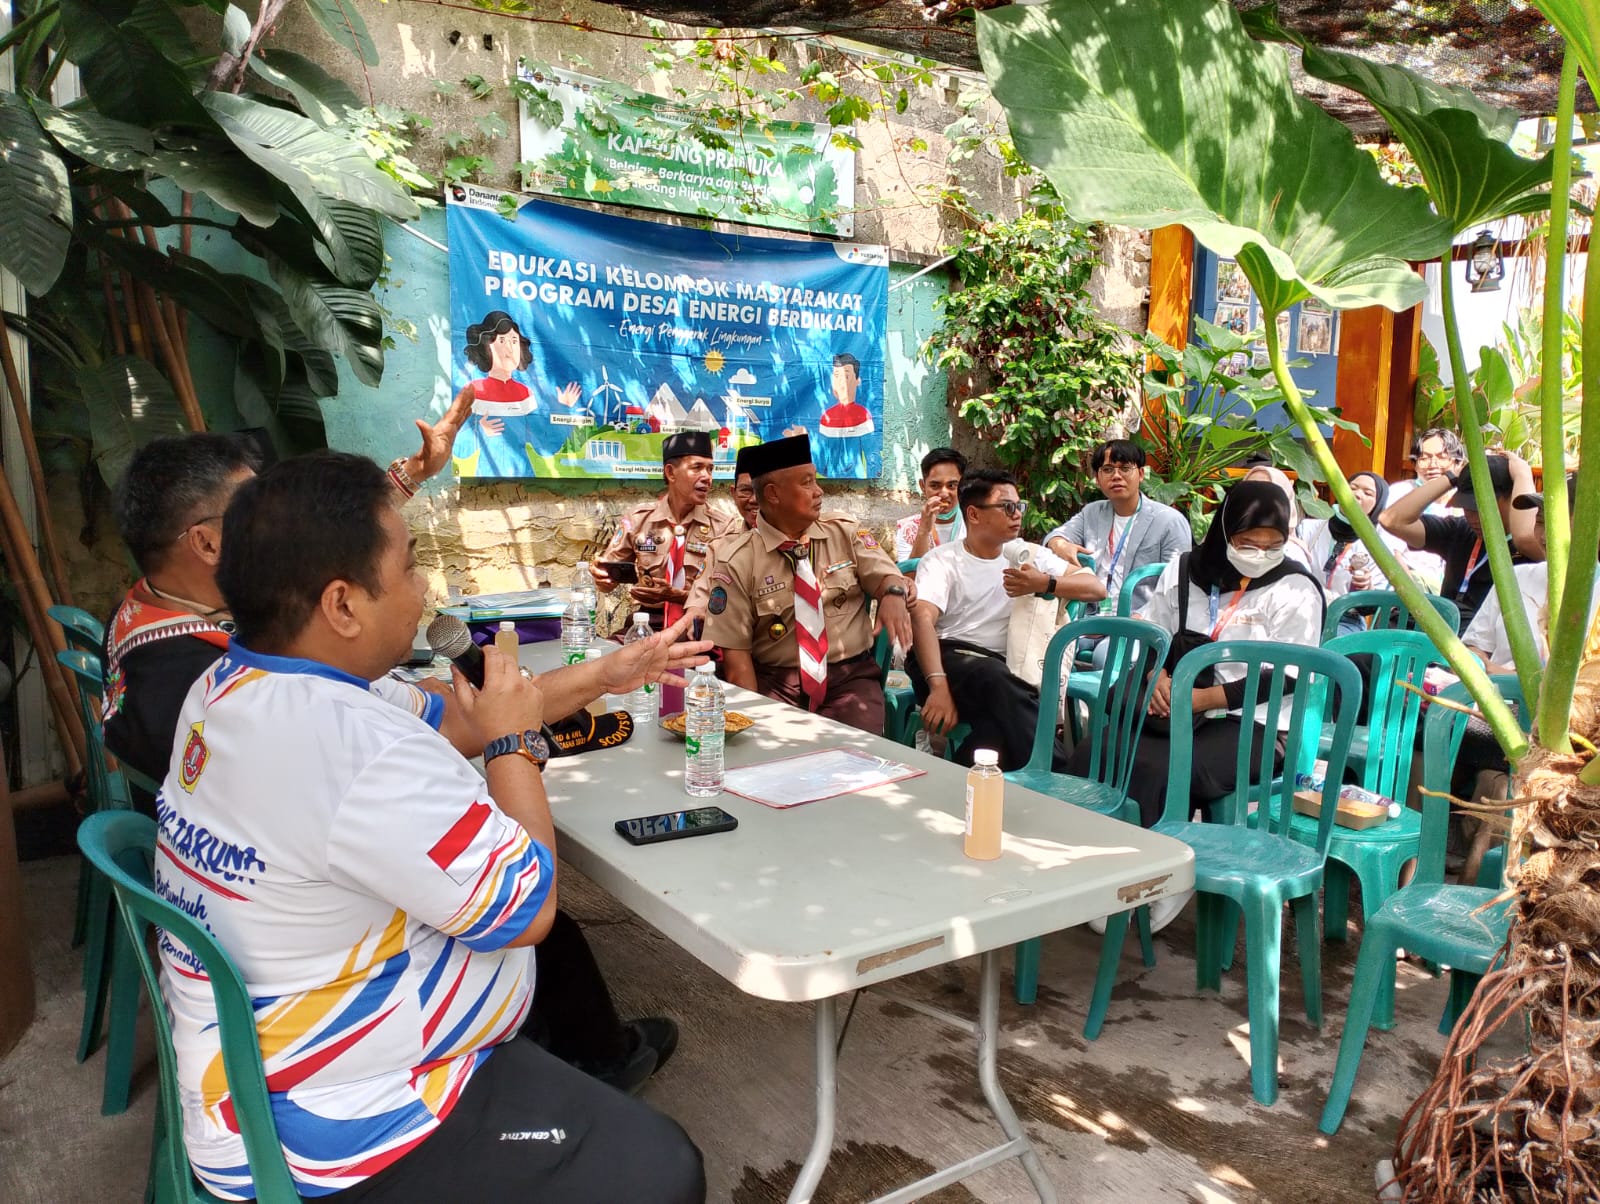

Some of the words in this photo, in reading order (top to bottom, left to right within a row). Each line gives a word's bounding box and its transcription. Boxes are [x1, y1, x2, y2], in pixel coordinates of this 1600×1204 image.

[705, 147, 785, 178] PRAMUKA
[658, 167, 713, 187] Berkarya
[715, 176, 739, 190] dan
[469, 188, 505, 202] Dananta
[645, 182, 676, 199] Gang
[678, 186, 709, 202] Hijau
[488, 250, 597, 283] EDUKASI
[606, 264, 729, 298] KELOMPOK
[736, 282, 863, 312] MASYARAKAT
[484, 276, 615, 310] PROGRAM
[623, 293, 680, 317] DESA
[689, 299, 762, 325] ENERGI
[768, 308, 863, 333] BERDIKARI
[619, 319, 655, 343] Energi
[658, 321, 709, 346] Penggerak
[710, 326, 763, 350] Lingkungan
[552, 416, 571, 424] Energi
[615, 466, 634, 474] Energi
[598, 720, 631, 747] SCOUTS
[172, 817, 266, 882] TARUNA
[500, 1132, 531, 1141] ACTIVE
[532, 1131, 550, 1140] GEN
